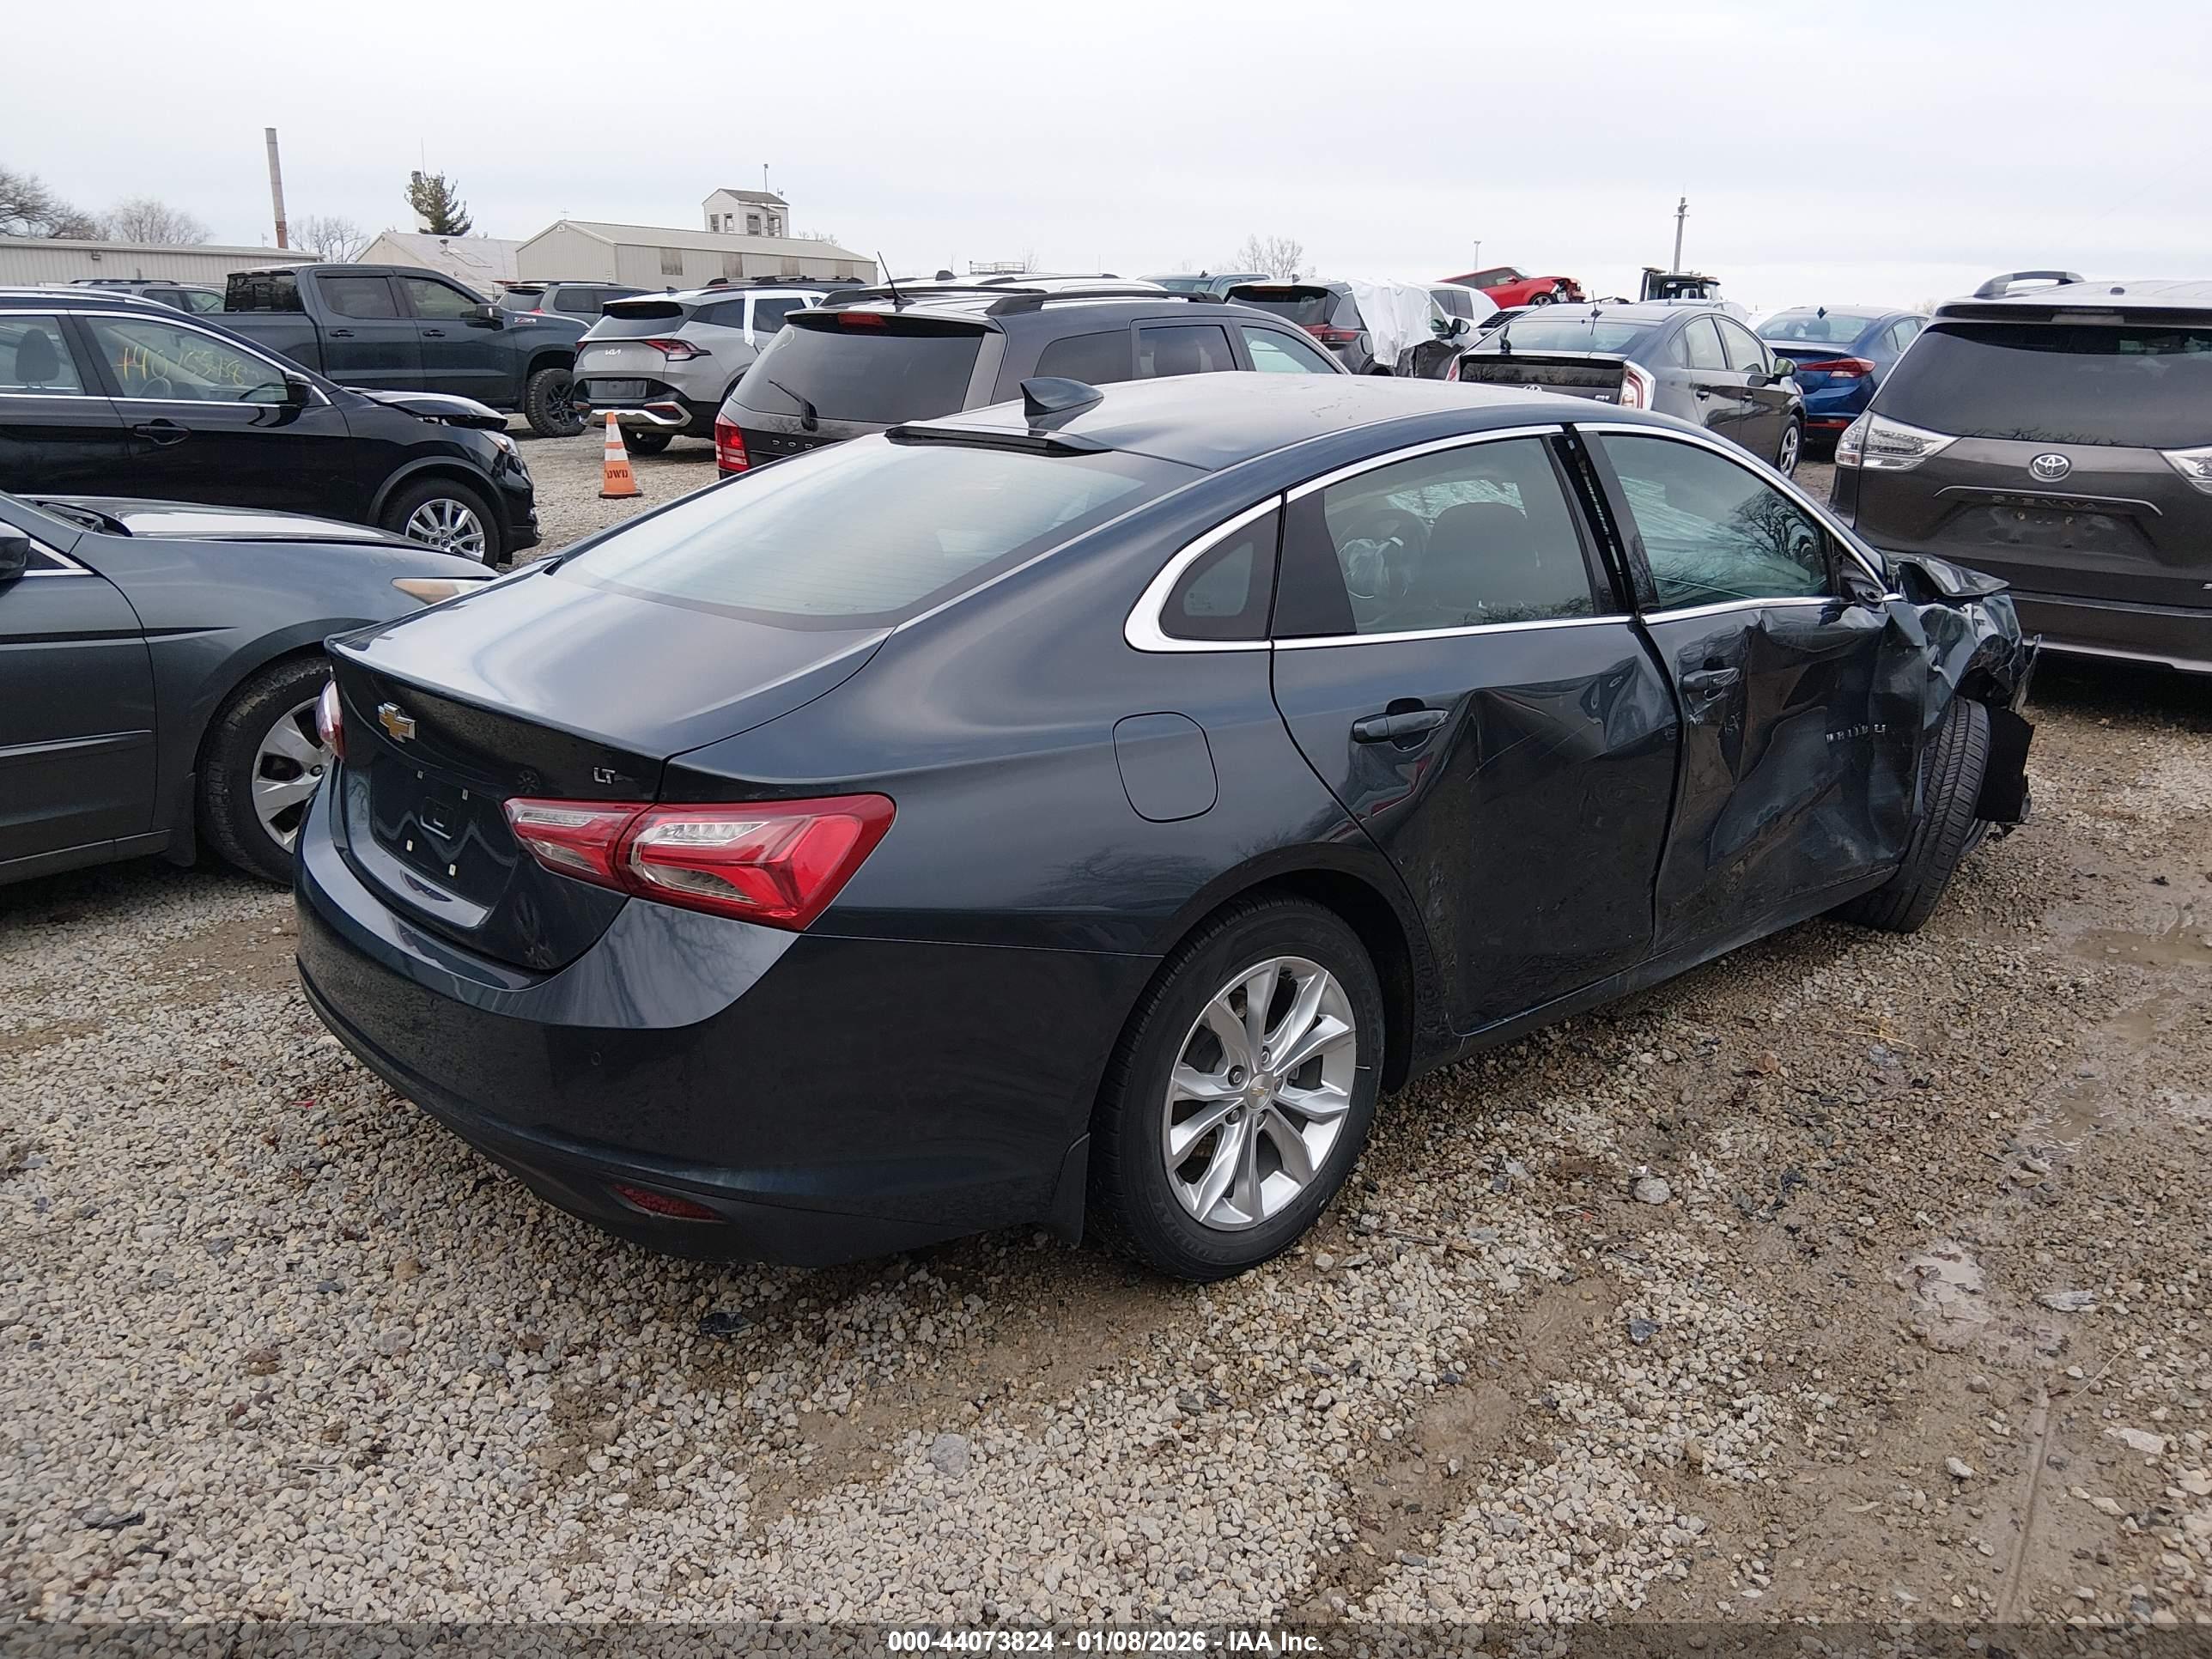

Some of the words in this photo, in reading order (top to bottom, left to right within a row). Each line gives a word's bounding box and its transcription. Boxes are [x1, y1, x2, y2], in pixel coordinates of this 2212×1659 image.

[772, 439, 814, 449] DOD
[606, 469, 629, 479] DWD
[593, 767, 616, 784] LT
